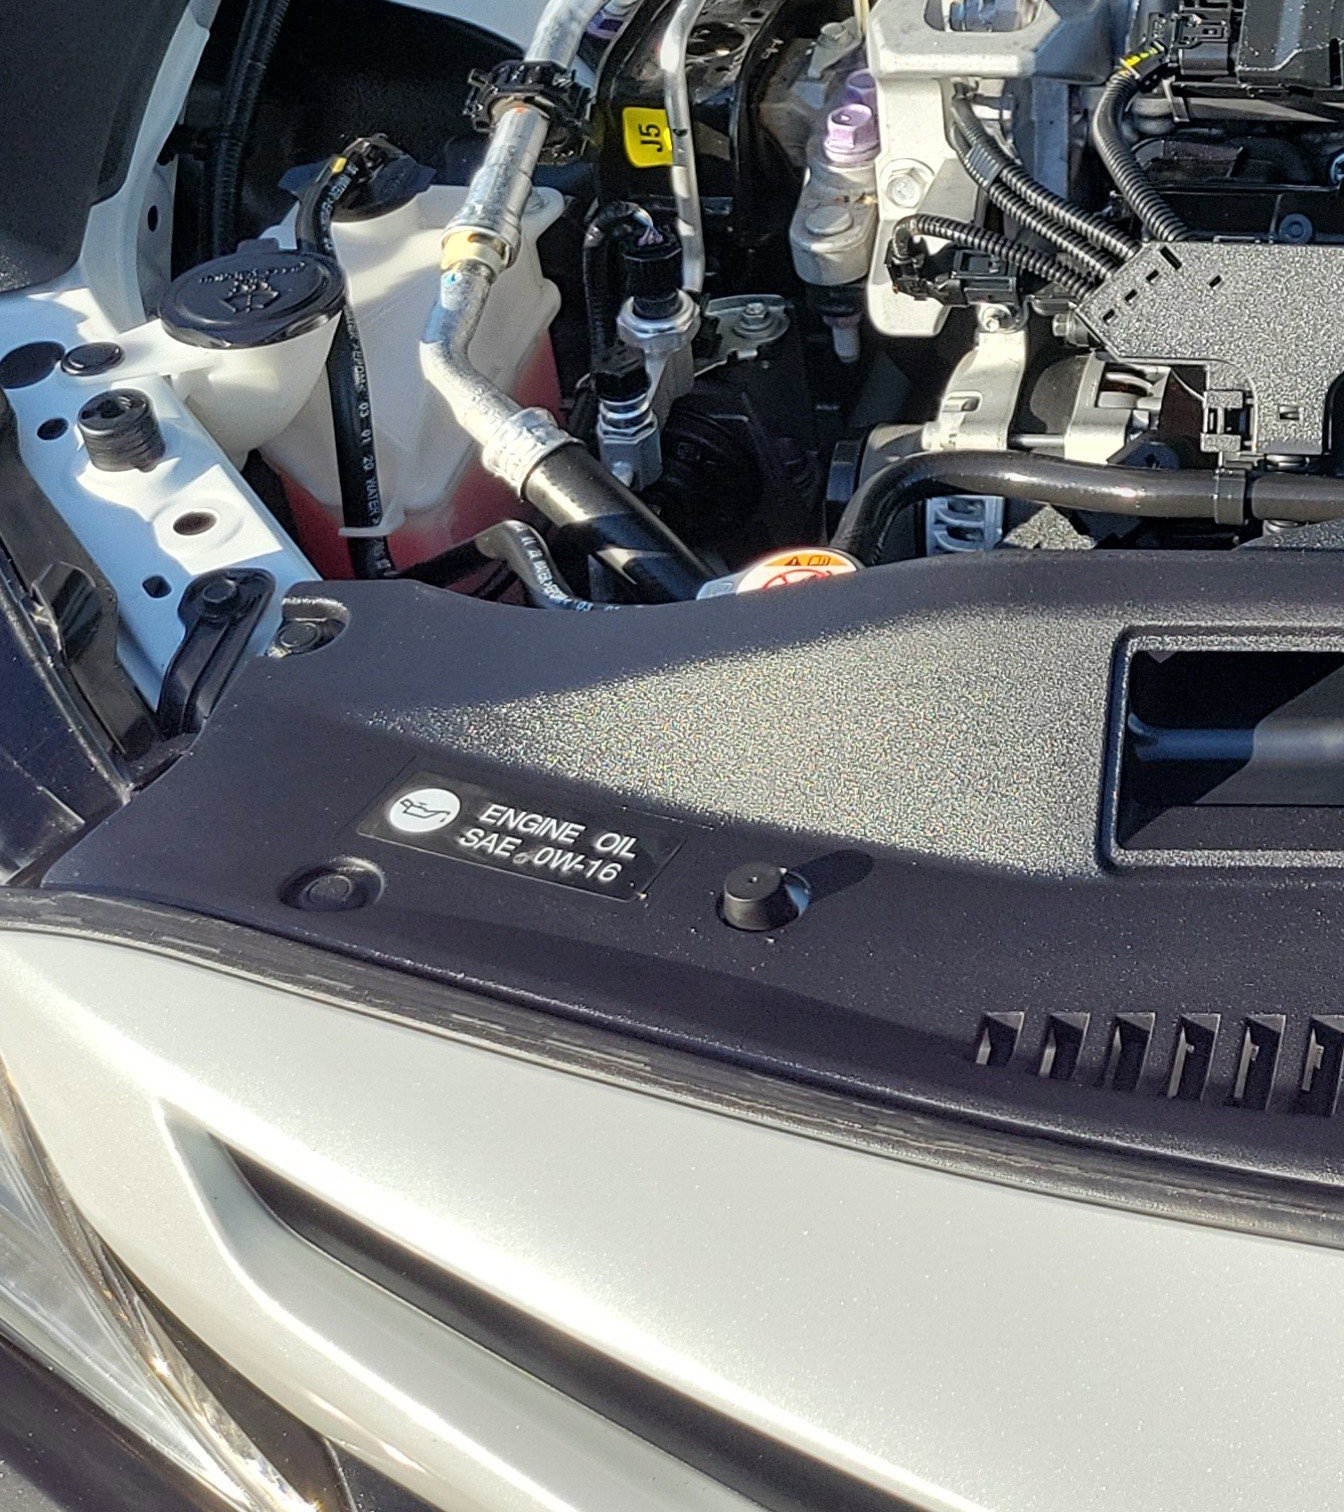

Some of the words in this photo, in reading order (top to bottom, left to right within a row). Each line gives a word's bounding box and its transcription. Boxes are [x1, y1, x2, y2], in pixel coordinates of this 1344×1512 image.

[638, 123, 663, 153] J5
[359, 402, 370, 418] 03
[363, 455, 375, 470] 20
[478, 803, 586, 845] ENGINE
[595, 832, 638, 859] OIL
[458, 828, 523, 858] SAE
[533, 846, 623, 882] 0W-16
